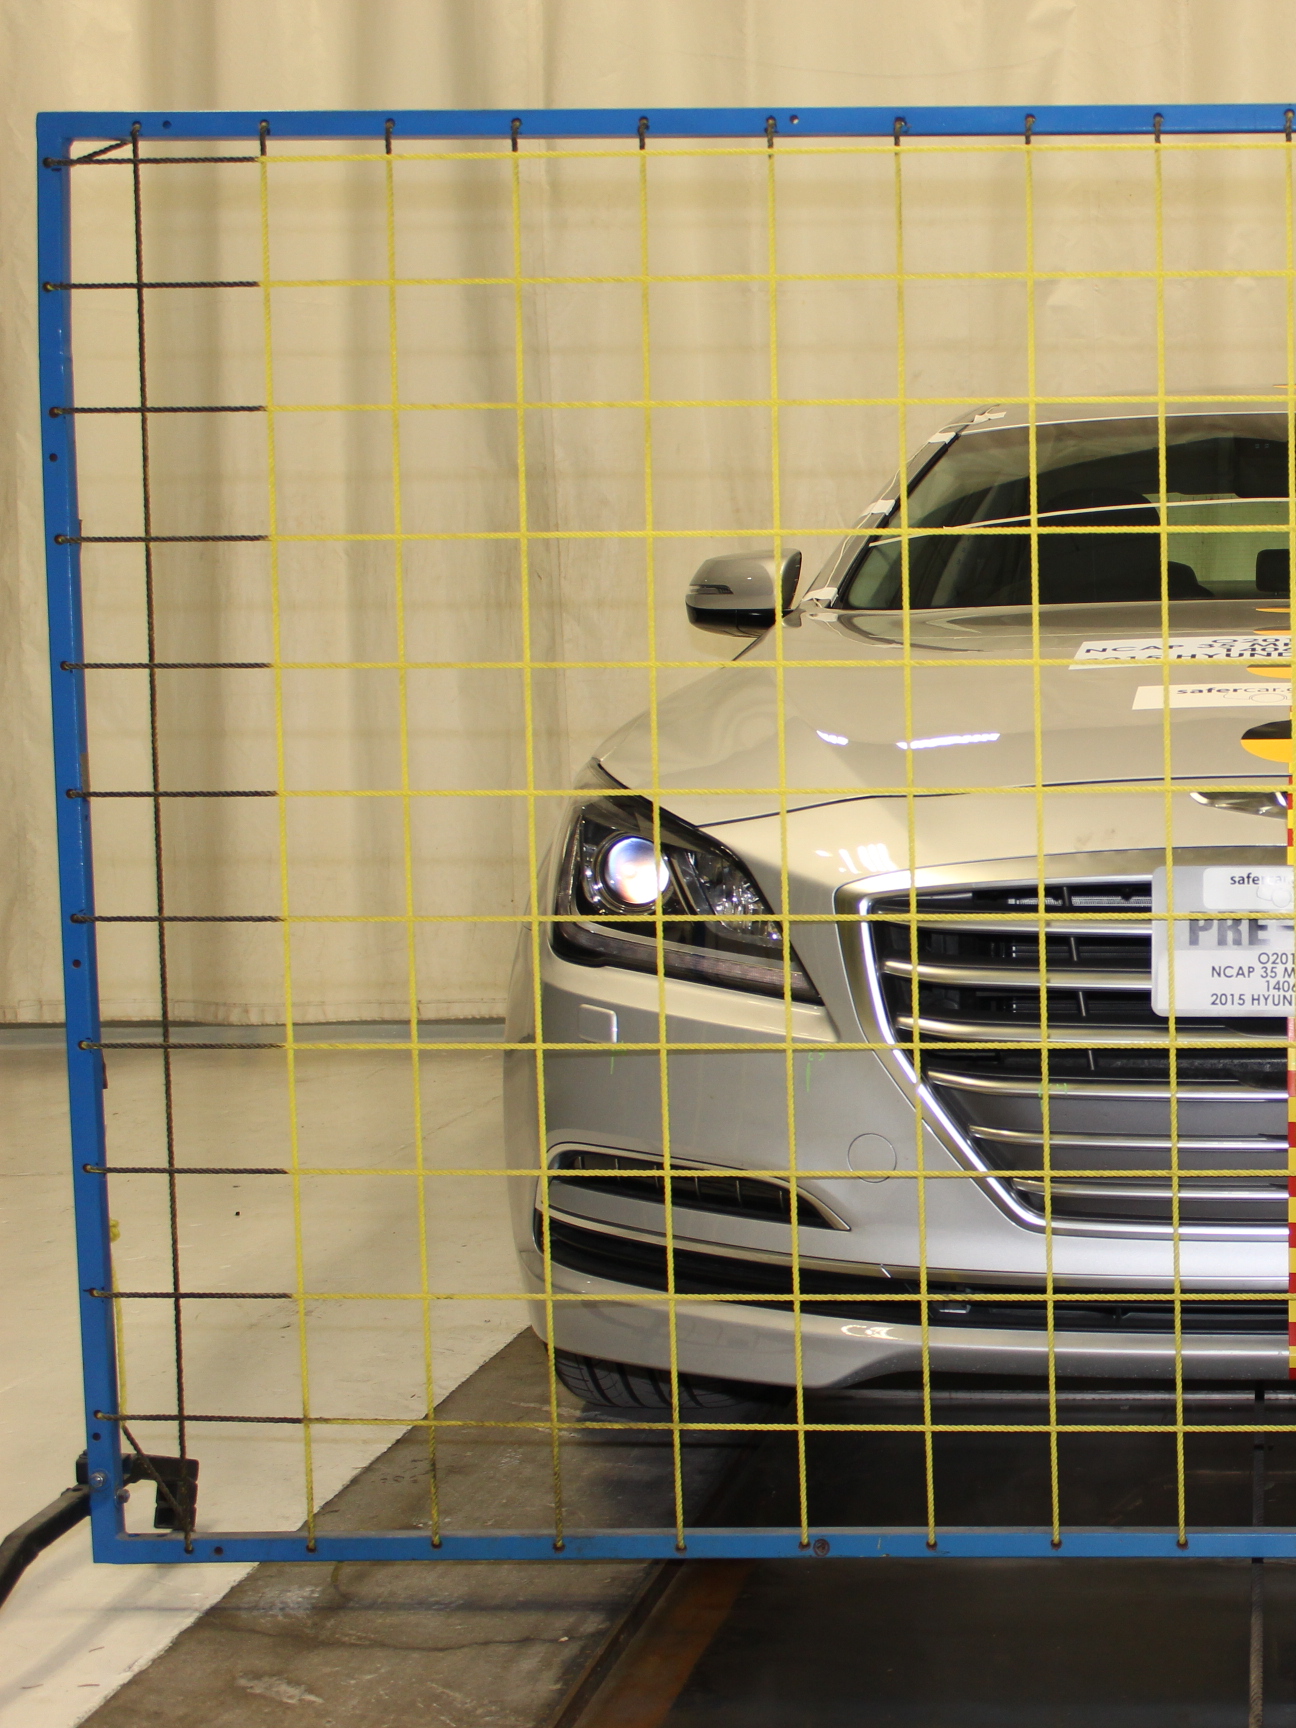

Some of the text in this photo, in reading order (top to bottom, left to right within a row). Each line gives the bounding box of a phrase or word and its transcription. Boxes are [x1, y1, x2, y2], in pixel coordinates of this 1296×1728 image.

[1085, 644, 1184, 653] NCAP
[1211, 965, 1256, 979] NCAP
[1260, 966, 1278, 979] 35
[1210, 993, 1246, 1007] 2015
